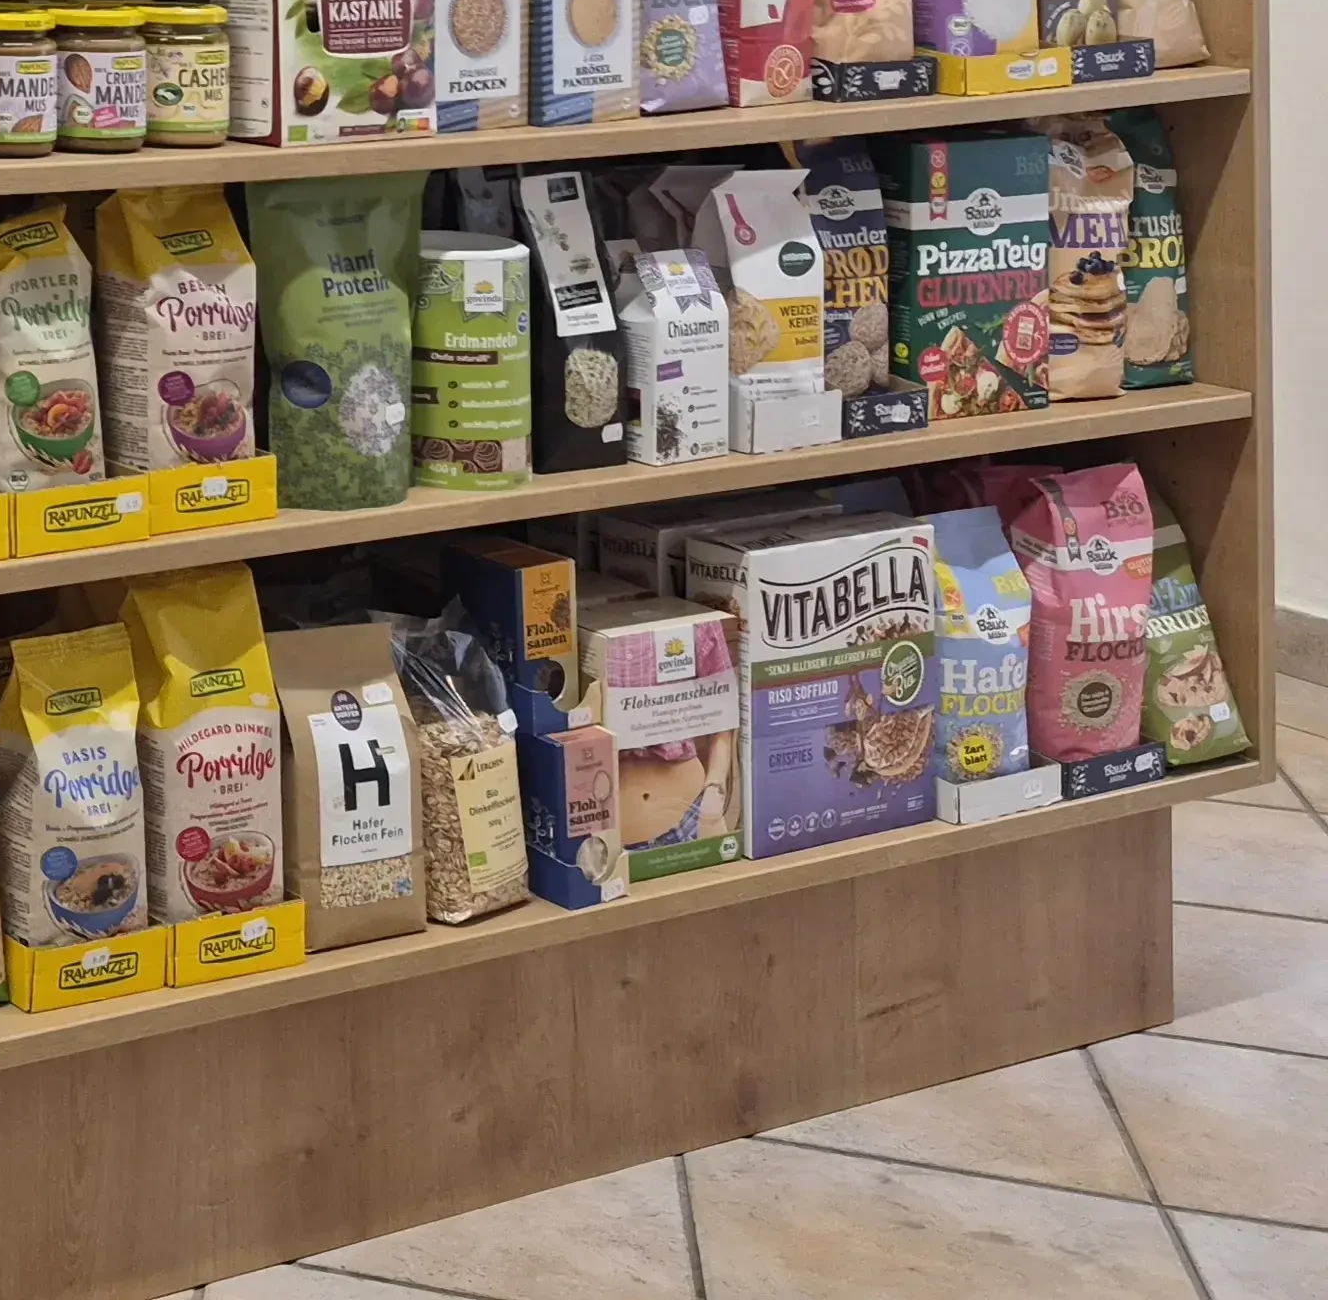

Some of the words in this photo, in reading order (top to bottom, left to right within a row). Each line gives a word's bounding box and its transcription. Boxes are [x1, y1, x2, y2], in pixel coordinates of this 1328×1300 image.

[328, 0, 404, 23] KASTANIE
[205, 89, 223, 102] MUS
[449, 78, 507, 94] FLOCKEN
[25, 100, 47, 113] MUS
[120, 105, 139, 118] MUS
[964, 203, 1002, 220] Bauck
[328, 250, 379, 275] Hanf
[9, 273, 79, 296] SPORTLER
[321, 273, 391, 298] Protein
[156, 294, 256, 333] Porridge
[780, 303, 819, 317] WEIZEN
[667, 318, 721, 339] Chiasamen
[789, 315, 819, 329] KEIME
[48, 503, 119, 527] RAPUNZEL
[1086, 547, 1118, 564] Bauck
[760, 555, 929, 642] VITABELLA
[525, 622, 556, 637] Floh
[976, 616, 1008, 632] Bauck
[526, 634, 568, 651] samen
[657, 655, 694, 674] govinda
[193, 672, 241, 693] RAPUNZEL
[620, 680, 731, 712] Flohsamenschalen
[768, 688, 793, 705] RISO
[794, 680, 839, 701] SOFFIATO
[177, 723, 232, 754] HILDEGARD
[234, 721, 274, 742] DINKEL
[63, 746, 107, 765] BASIS
[768, 747, 814, 768] CRISPIES
[963, 742, 987, 757] Zart
[963, 750, 988, 766] blatt
[176, 742, 276, 789] Porridge
[339, 738, 391, 811] H
[1104, 759, 1134, 776] Bauck
[44, 759, 141, 809] Porridge
[568, 799, 597, 814] Floh
[352, 816, 386, 831] Hafer
[569, 808, 611, 827] samen
[332, 830, 378, 847] Flocken
[380, 825, 404, 840] Fein
